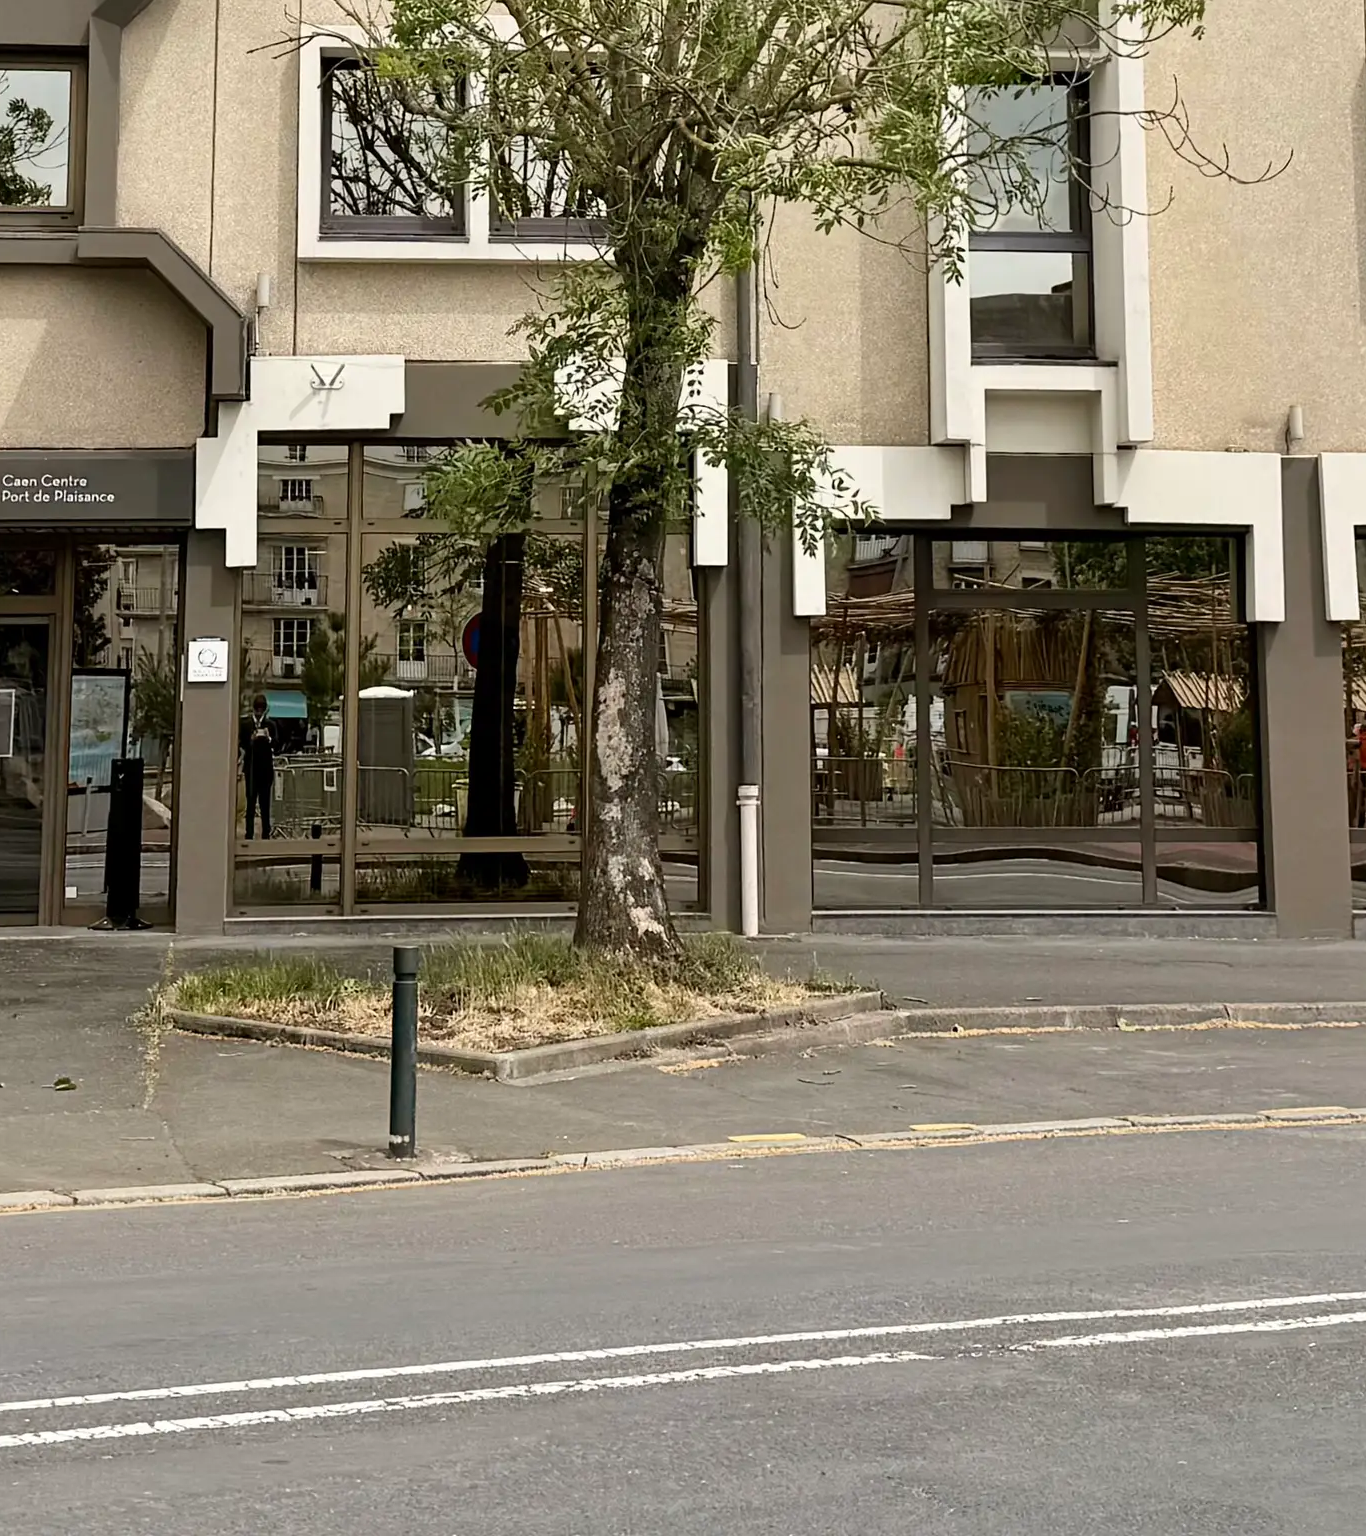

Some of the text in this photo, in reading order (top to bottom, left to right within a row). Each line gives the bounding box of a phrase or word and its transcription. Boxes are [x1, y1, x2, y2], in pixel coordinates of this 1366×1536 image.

[1, 474, 88, 487] Caen Centre
[1, 490, 116, 503] Port de Plaisance
